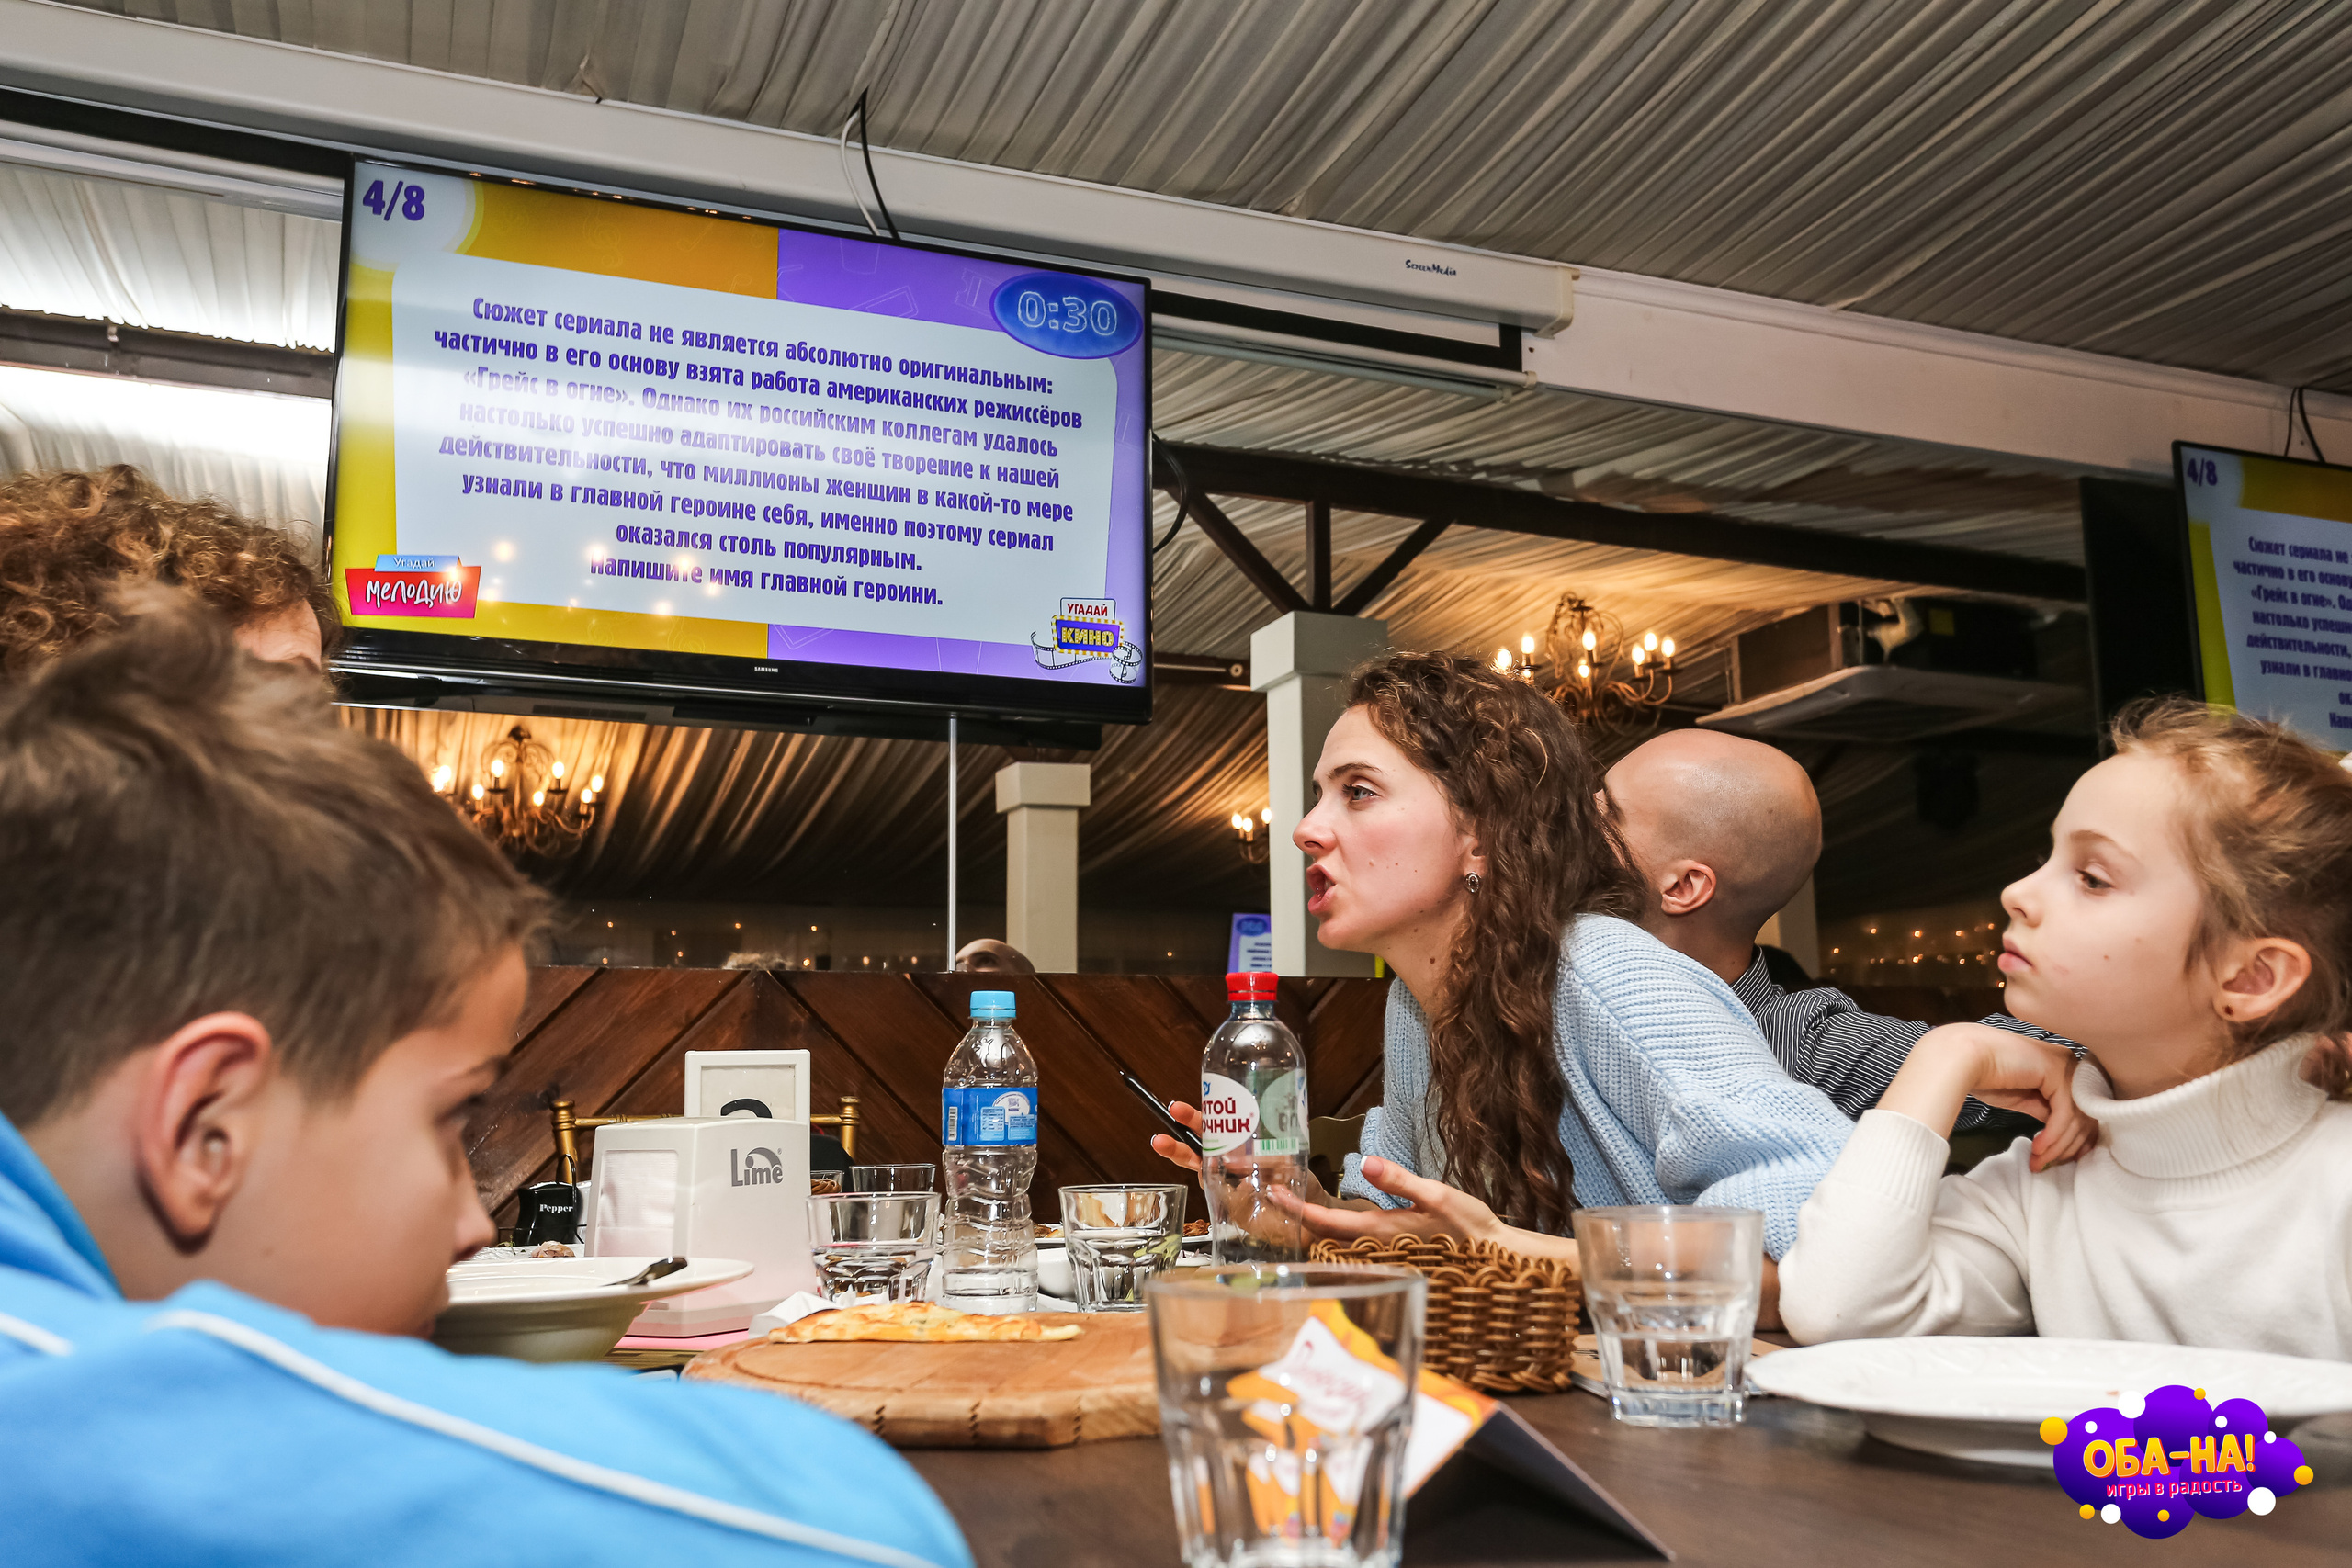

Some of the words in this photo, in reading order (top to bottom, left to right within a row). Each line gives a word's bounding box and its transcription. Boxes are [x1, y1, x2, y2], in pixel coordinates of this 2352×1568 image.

[362, 180, 425, 221] 4/8
[1017, 290, 1118, 336] 0:30
[473, 298, 548, 327] Сюжет
[554, 312, 642, 340] сериала
[650, 325, 674, 344] не
[681, 329, 779, 358] является
[786, 341, 892, 373] абсолютно
[899, 358, 1053, 394] оригинальным:
[435, 331, 537, 360] частично
[546, 345, 559, 362] в
[566, 347, 602, 367] его
[608, 353, 680, 380] основу
[686, 362, 744, 387] взята
[752, 370, 820, 396] работа
[827, 380, 967, 414] американских
[974, 399, 1082, 429] режиссёров
[463, 367, 538, 395] «Грейс
[546, 378, 559, 397] в
[567, 381, 635, 406] огне».
[642, 387, 720, 416] Однако
[727, 400, 753, 420] их
[760, 405, 876, 435] российским
[882, 419, 978, 447] коллегам
[983, 432, 1057, 457] удалось
[459, 403, 575, 434] настолько
[582, 416, 673, 445] успешно
[681, 428, 826, 461] адаптировать
[832, 446, 876, 468] своё
[882, 452, 973, 479] творение
[979, 463, 990, 480] к
[997, 466, 1059, 489] нашей
[439, 435, 653, 479] действительности,
[661, 460, 696, 480] что
[703, 465, 819, 494] миллионы
[825, 478, 910, 503] женщин
[917, 489, 928, 505] в
[935, 491, 1021, 515] какой-то
[1027, 500, 1073, 522] мере
[2187, 458, 2218, 487] 4/8
[462, 473, 543, 500] узнали
[550, 483, 563, 501] в
[571, 485, 663, 512] главной
[671, 495, 756, 521] героине
[763, 503, 814, 529] себя,
[820, 511, 898, 537] именно
[904, 520, 982, 547] поэтому
[989, 528, 1054, 551] сериал
[393, 557, 435, 569] Угадай
[616, 524, 712, 550] оказался
[719, 534, 776, 557] столь
[784, 540, 922, 571] популярным.
[2248, 536, 2285, 556] Сюжет
[2289, 545, 2333, 562] сериала
[709, 567, 753, 589] имя
[761, 571, 847, 597] главной
[854, 581, 943, 605] героини.
[2233, 560, 2285, 579] частично
[2298, 569, 2316, 583] его
[1067, 603, 1108, 616] УГАДАЙ
[2252, 611, 2310, 629] настолько
[2312, 617, 2352, 634] успешн
[1061, 626, 1114, 648] КИНО
[730, 1147, 784, 1187] Lime
[539, 1203, 574, 1213] Pepper
